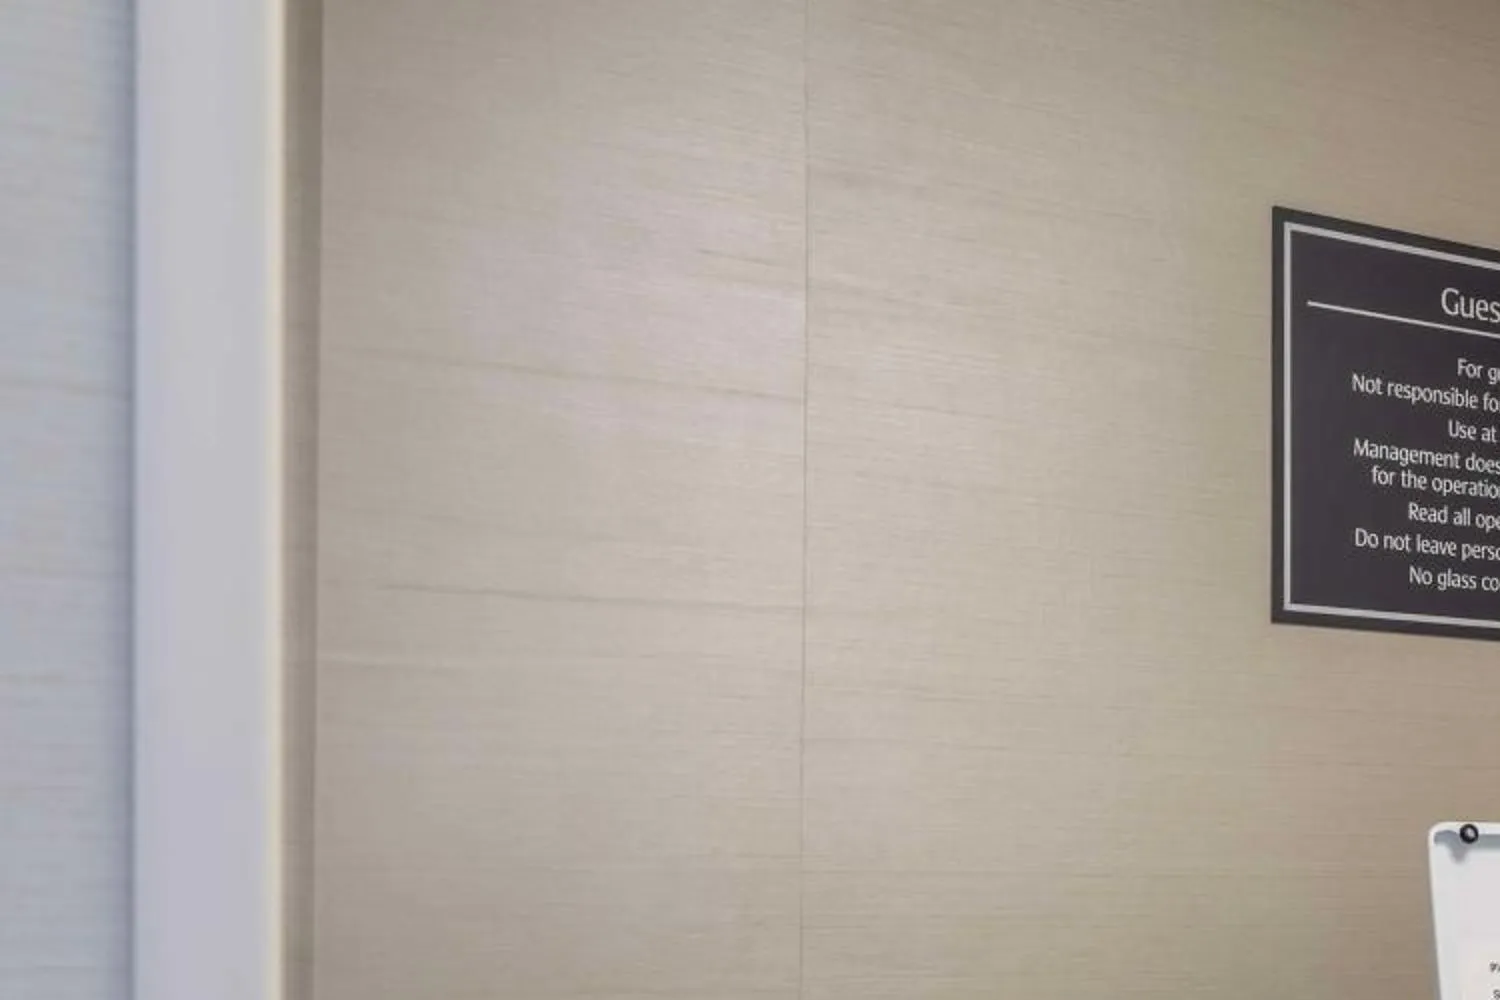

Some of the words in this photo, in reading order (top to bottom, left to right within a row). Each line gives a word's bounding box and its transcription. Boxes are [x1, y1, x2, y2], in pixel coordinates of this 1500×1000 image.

[1458, 358, 1483, 378] For
[1352, 373, 1383, 395] Not
[1388, 382, 1478, 408] responsible
[1448, 420, 1476, 440] Use
[1481, 426, 1497, 443] at
[1354, 438, 1460, 469] Management
[1371, 465, 1396, 485] for
[1401, 469, 1427, 490] the
[1408, 502, 1448, 524] Read
[1453, 508, 1470, 526] all
[1355, 528, 1379, 548] Do
[1384, 534, 1411, 552] not
[1416, 534, 1457, 556] leave
[1410, 566, 1432, 585] No
[1438, 570, 1476, 591] glass
